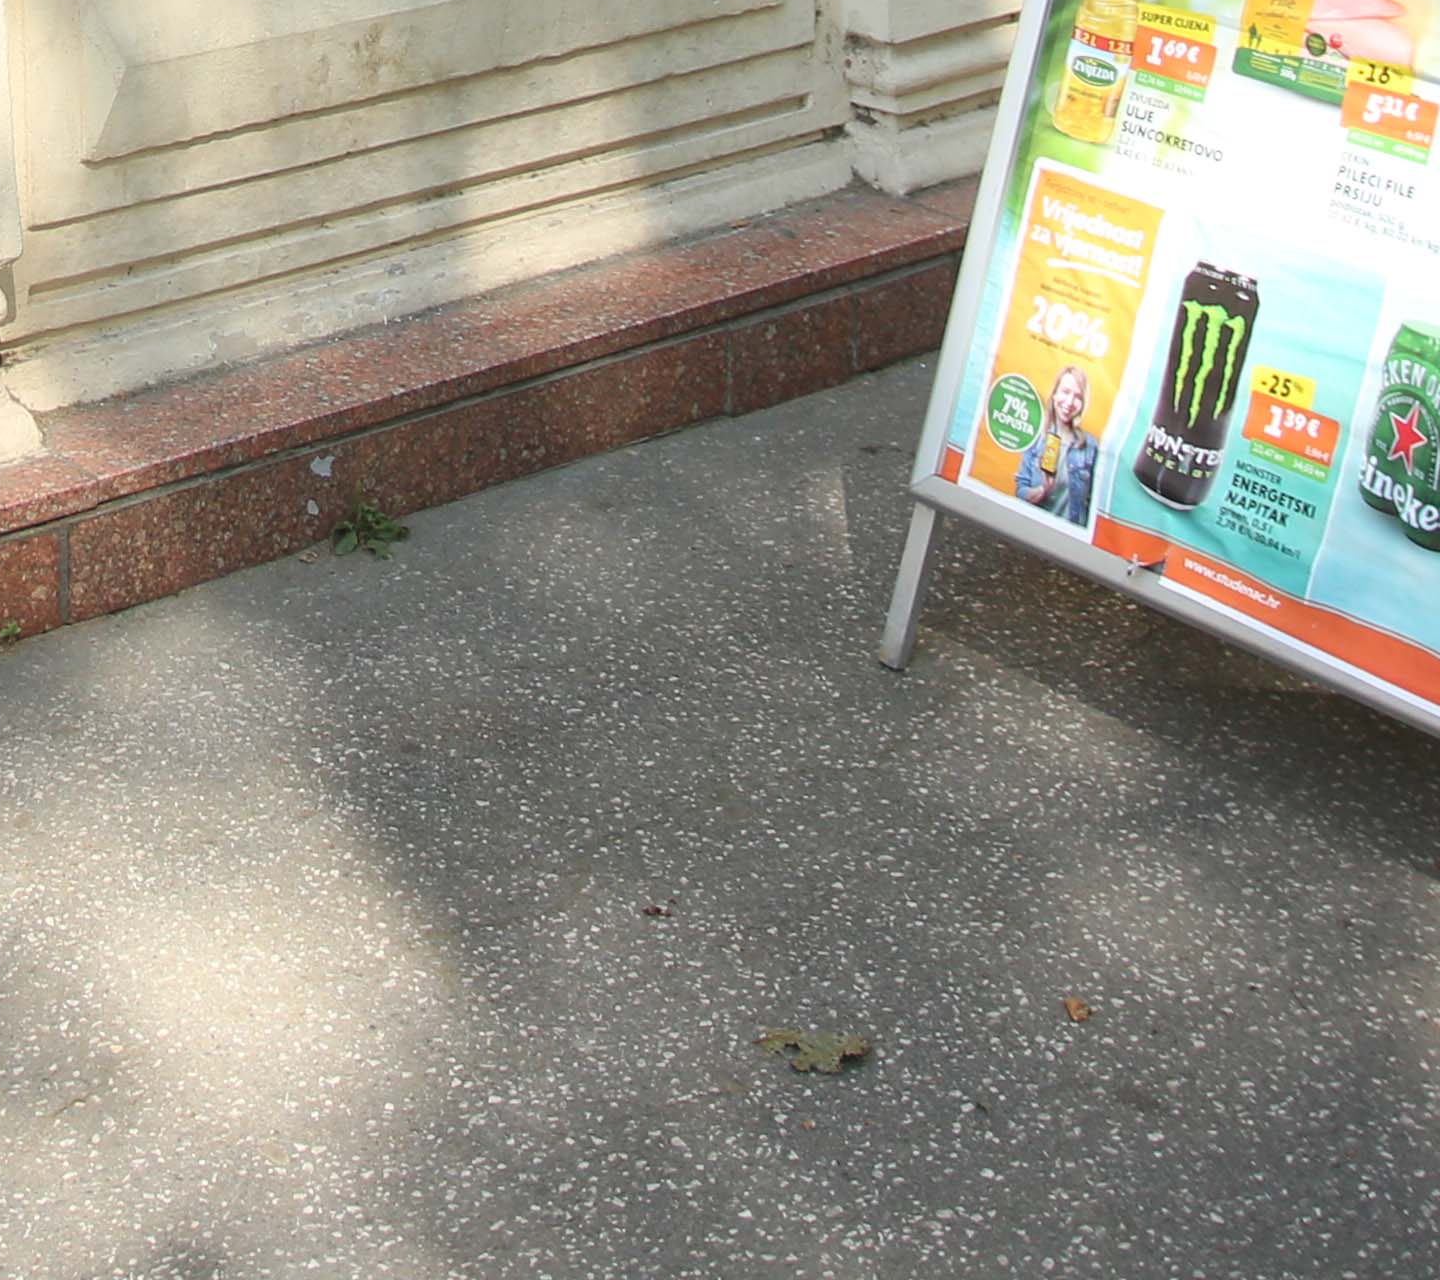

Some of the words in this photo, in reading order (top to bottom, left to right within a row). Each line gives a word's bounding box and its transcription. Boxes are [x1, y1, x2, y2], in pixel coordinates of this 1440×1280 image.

[1141, 11, 1172, 26] SUPER
[1174, 16, 1210, 32] CIJENA
[1126, 104, 1154, 123] ULJE
[1121, 121, 1224, 162] SUNCOKRETOVO
[1385, 179, 1416, 200] FILE
[1029, 223, 1051, 246] za
[1025, 295, 1110, 359] 20%
[1001, 392, 1030, 422] 7%
[992, 410, 1035, 437] POPUSTA
[1236, 459, 1282, 485] MONSTER
[1225, 490, 1290, 527] NAPITAK
[1232, 473, 1317, 519] ENERGETSKI
[1184, 557, 1281, 609] www.studenac.hr
